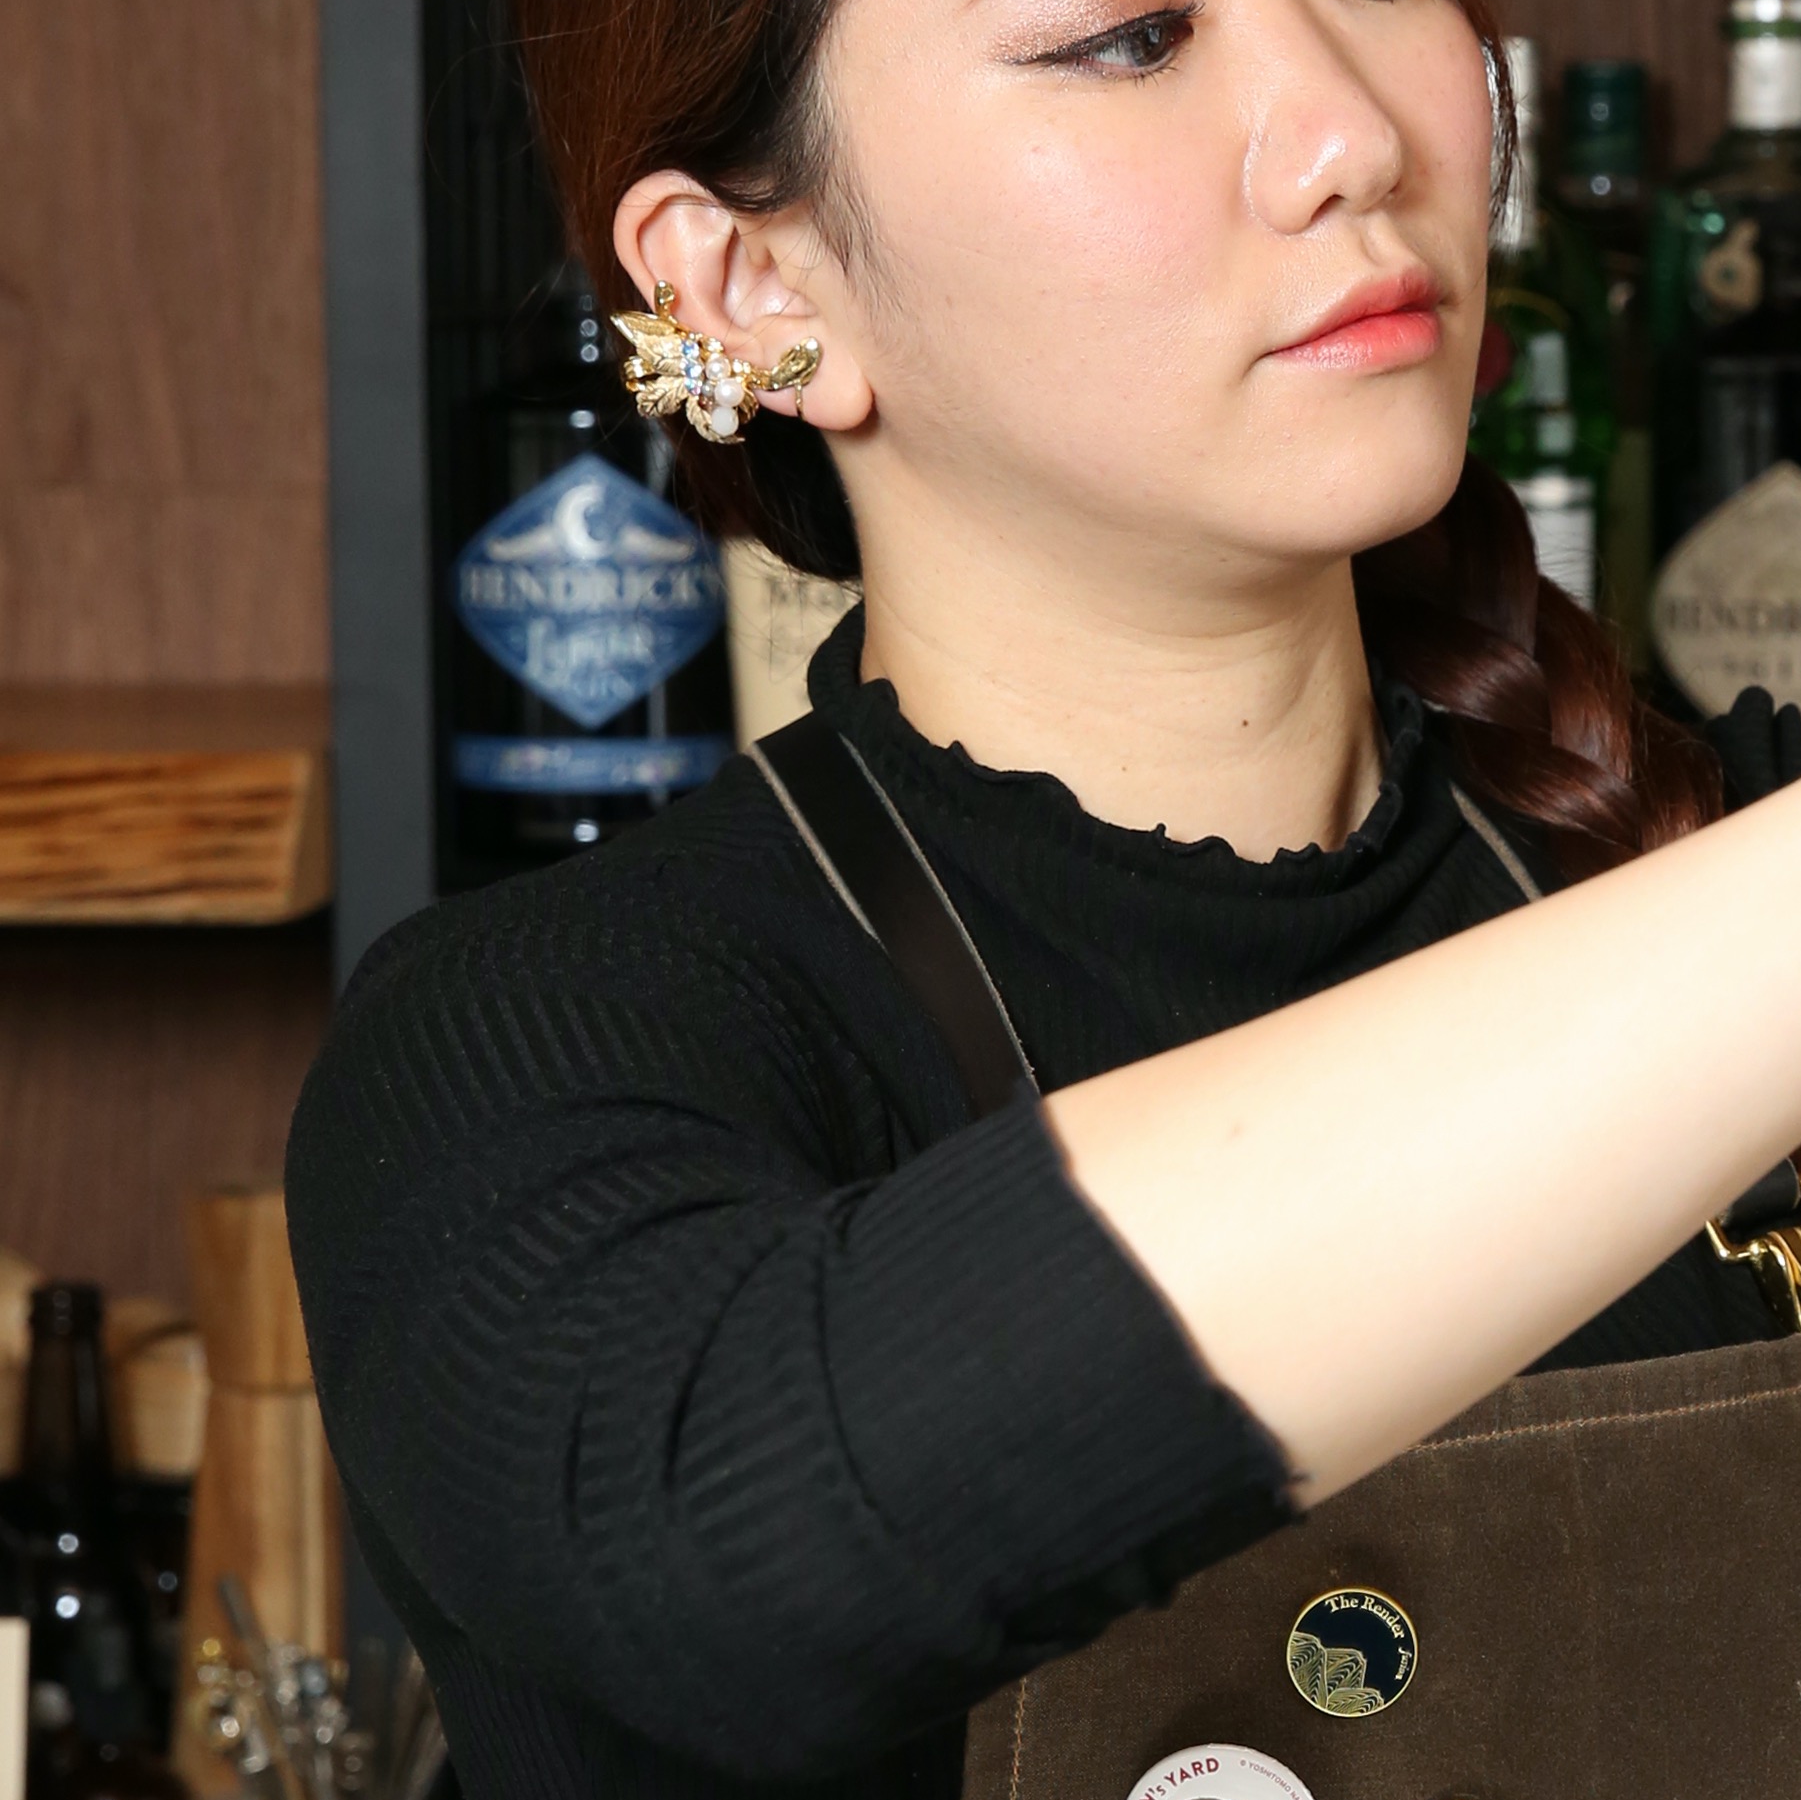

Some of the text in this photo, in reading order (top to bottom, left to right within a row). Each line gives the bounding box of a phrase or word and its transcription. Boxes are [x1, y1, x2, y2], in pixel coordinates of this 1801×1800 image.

[1325, 1595, 1359, 1613] The
[1360, 1595, 1405, 1639] Render
[1164, 1757, 1220, 1788] YARD
